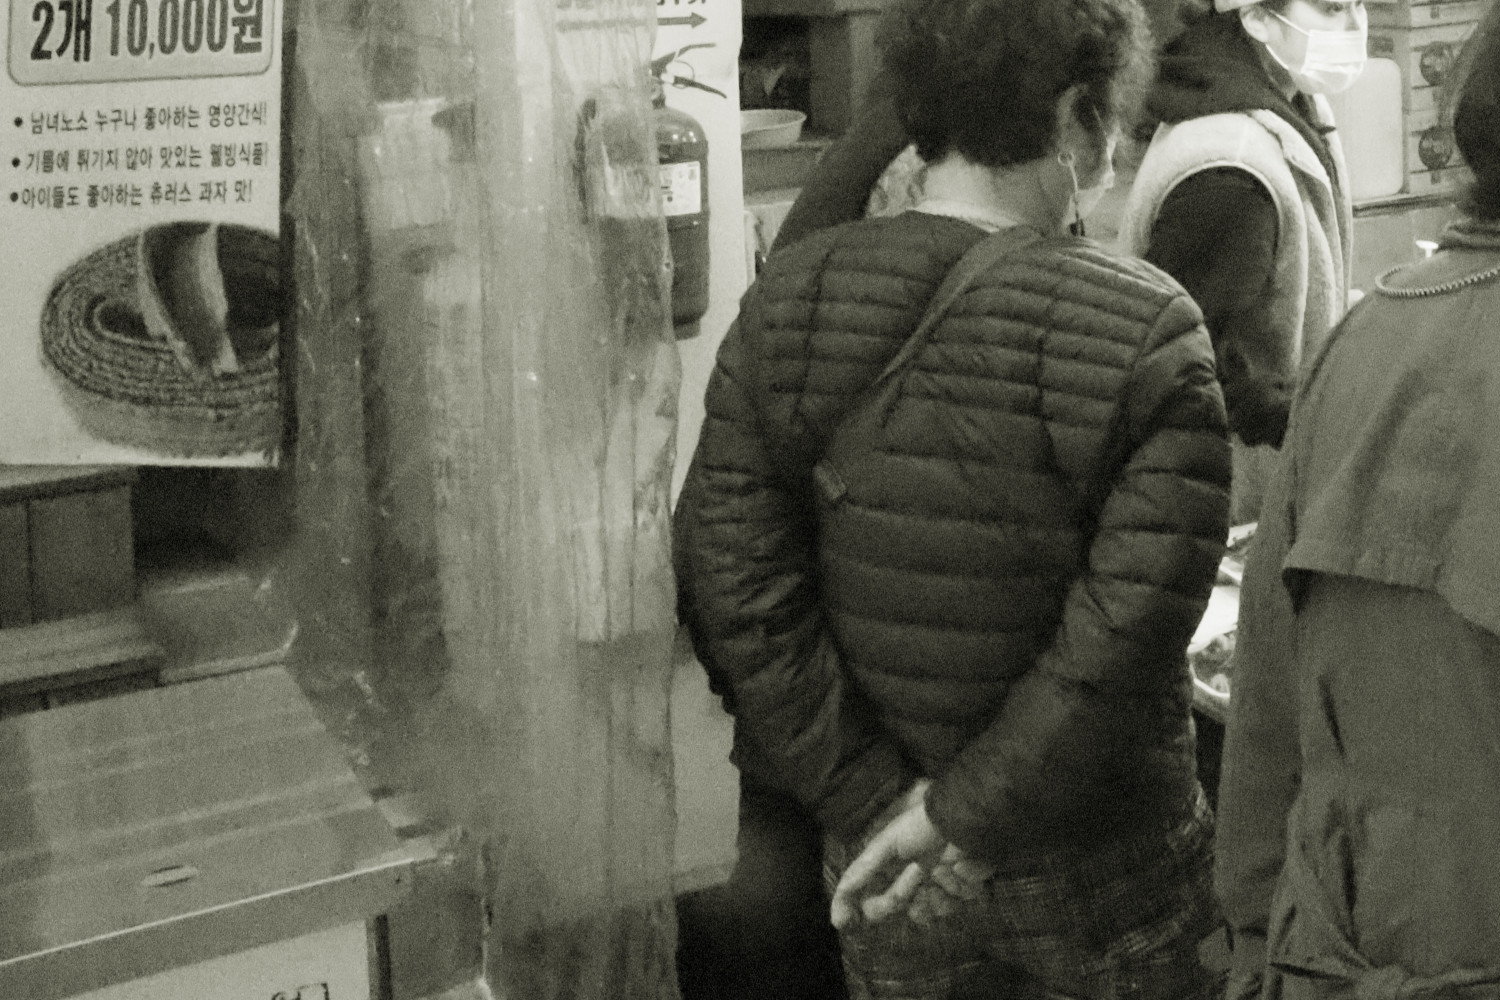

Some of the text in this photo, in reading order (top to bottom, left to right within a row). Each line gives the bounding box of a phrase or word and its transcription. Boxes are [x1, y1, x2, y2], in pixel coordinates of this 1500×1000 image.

[31, 110, 89, 134] 남녀노소
[95, 108, 137, 132] 누구나
[144, 106, 201, 131] 좋아하는
[27, 150, 69, 173] 기름에
[160, 144, 202, 169] 맛있는
[21, 186, 79, 209] 아이들도
[87, 182, 143, 208] 좋아하는
[199, 180, 228, 204] 과자
